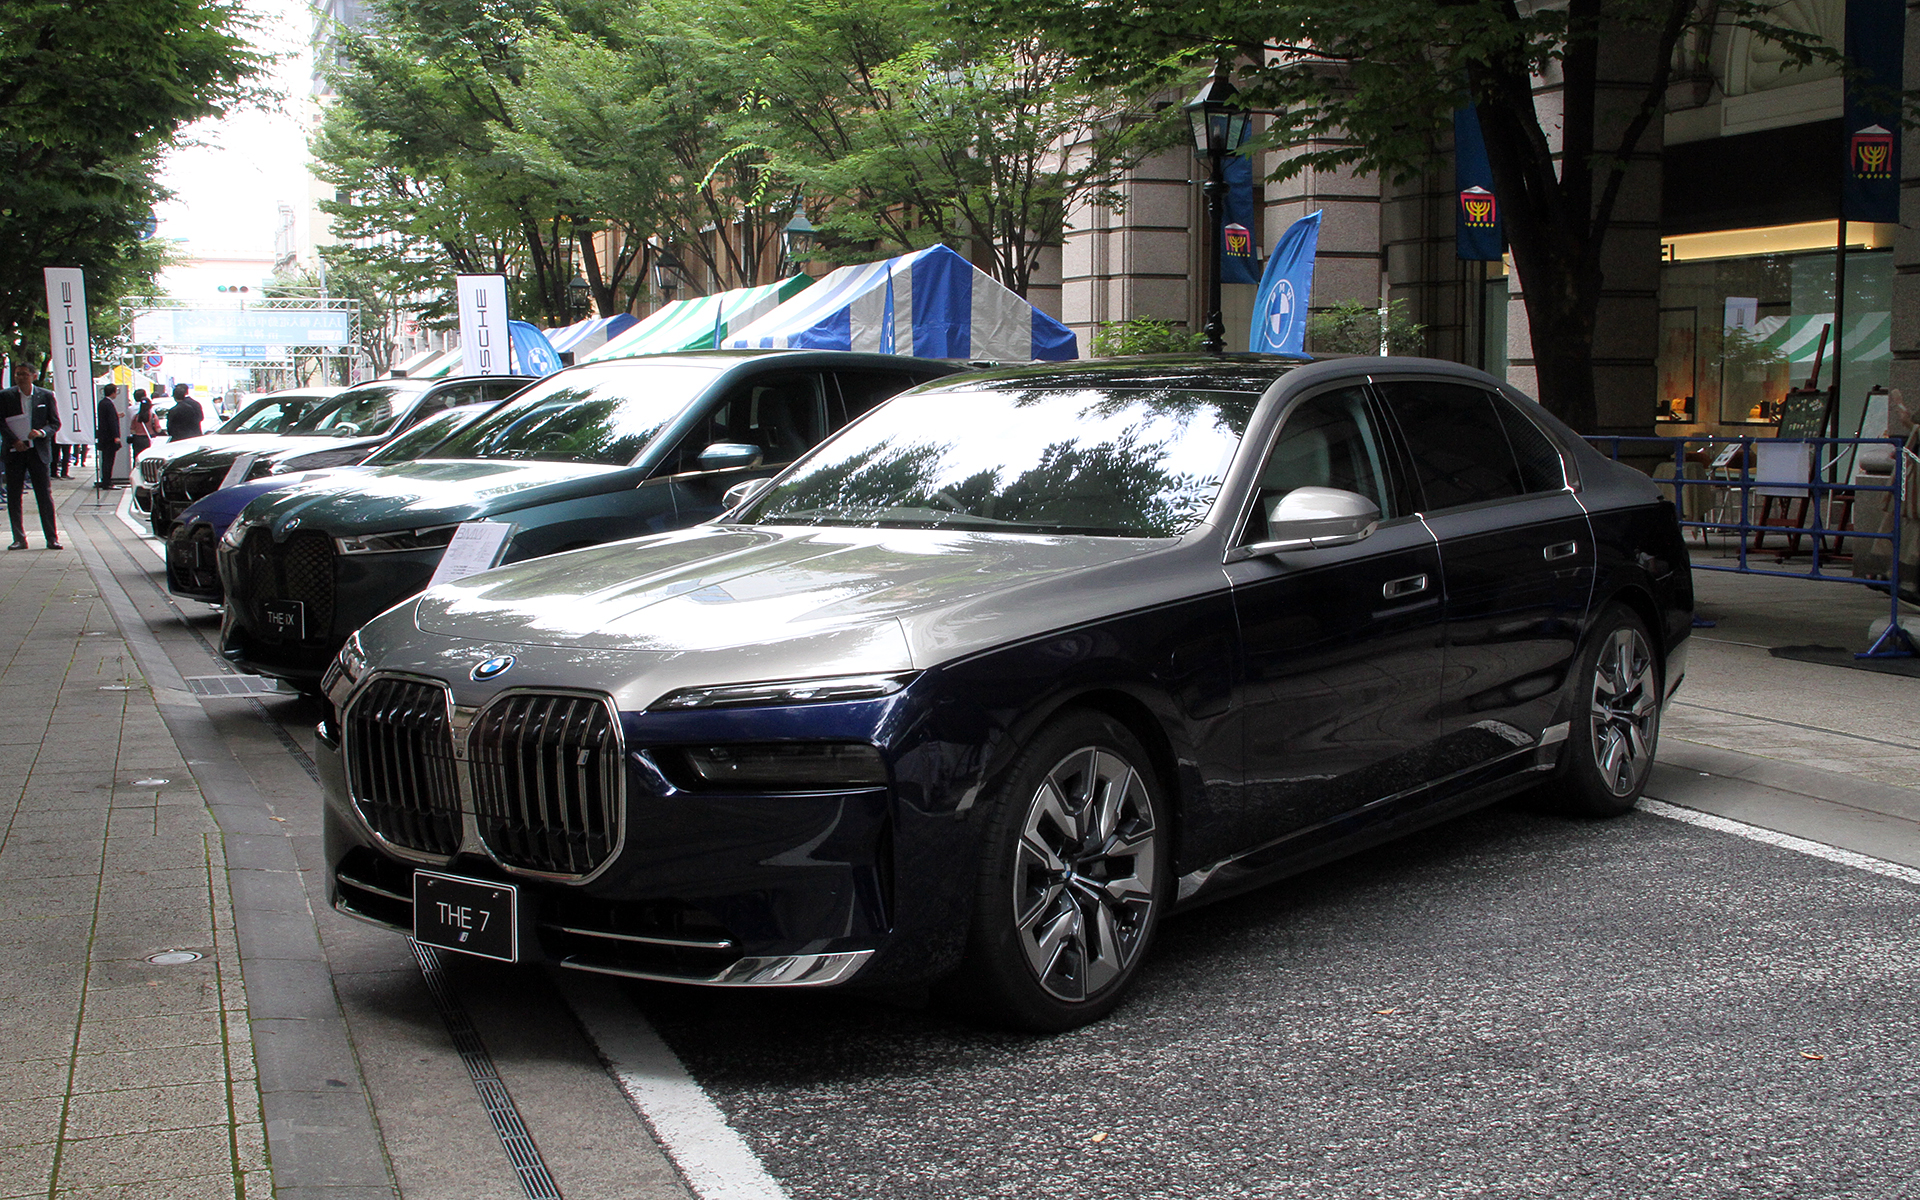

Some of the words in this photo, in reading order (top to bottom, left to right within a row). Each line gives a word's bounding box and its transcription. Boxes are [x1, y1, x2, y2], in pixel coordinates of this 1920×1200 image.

[61, 282, 81, 433] PORSCHE
[267, 611, 284, 624] THE
[436, 901, 473, 930] THE
[479, 910, 491, 932] 7
